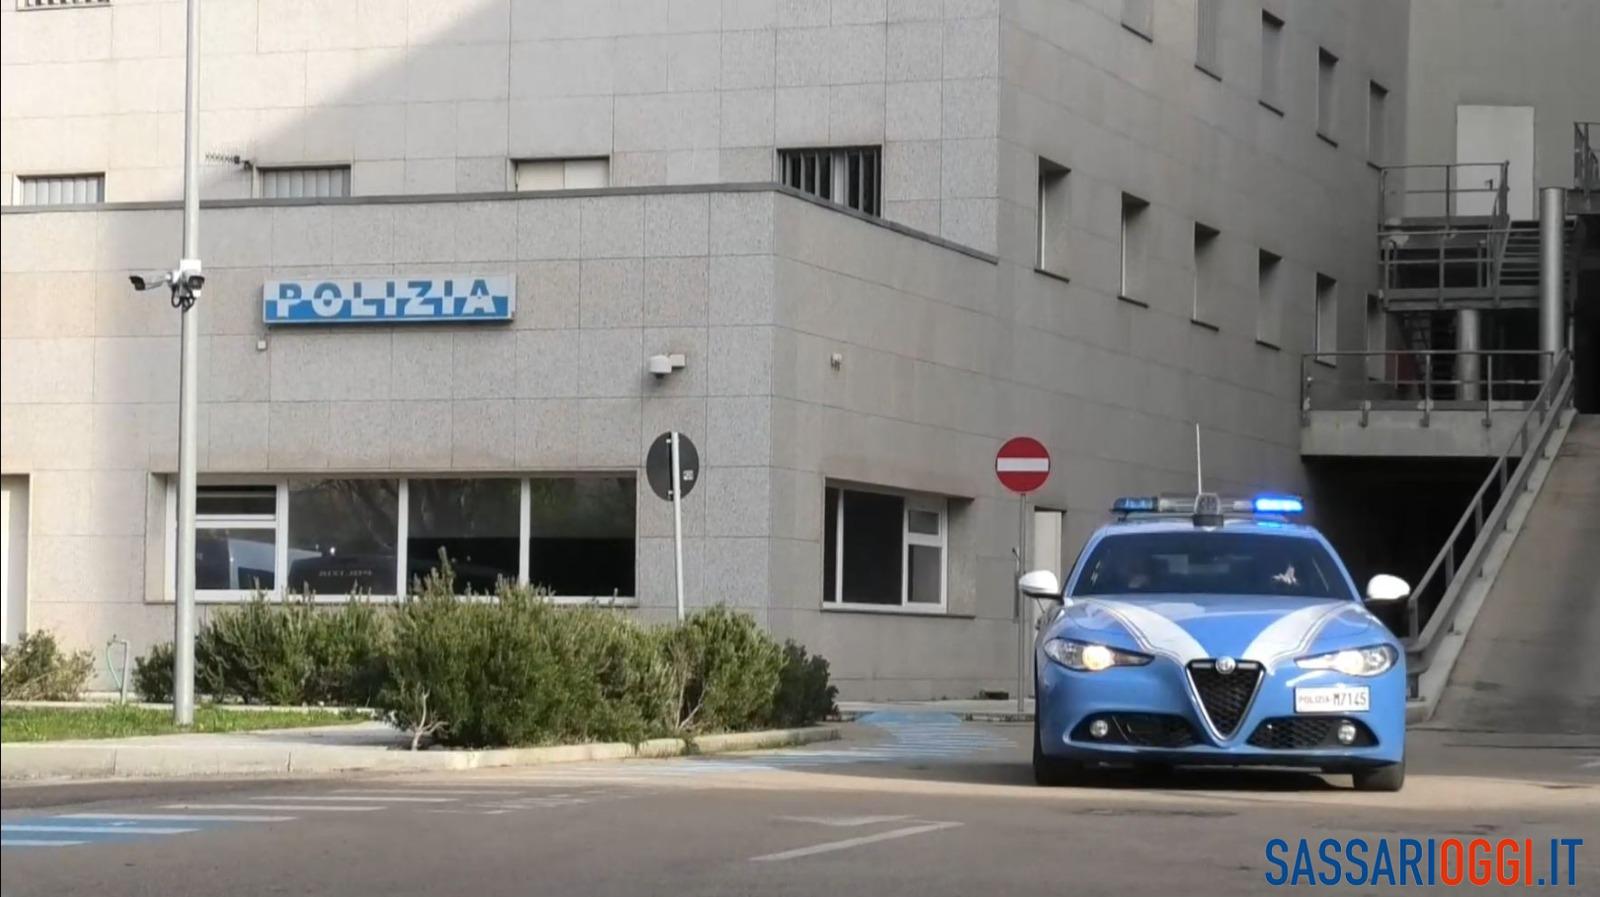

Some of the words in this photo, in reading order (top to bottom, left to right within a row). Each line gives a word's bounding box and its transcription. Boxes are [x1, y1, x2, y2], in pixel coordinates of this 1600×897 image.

[277, 279, 496, 318] POLIZIA
[1298, 695, 1330, 704] POLIZIA
[1333, 692, 1367, 706] M7145
